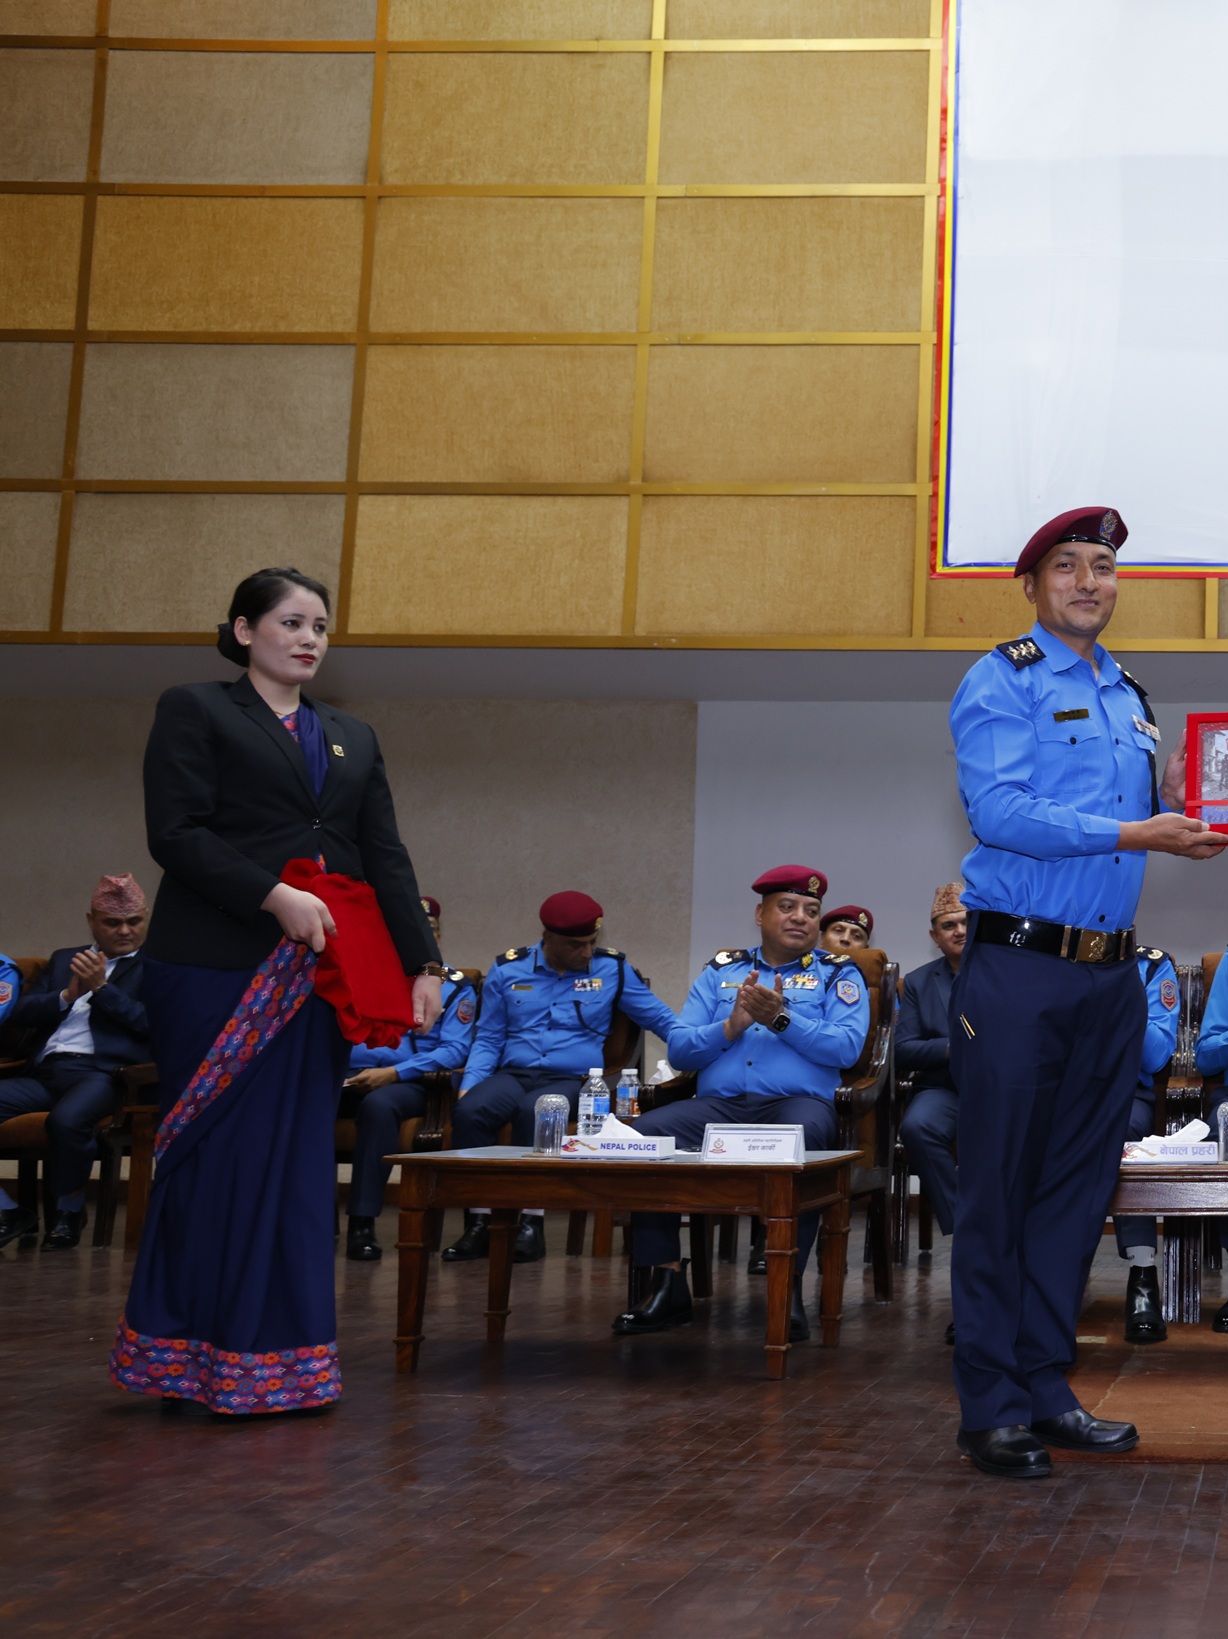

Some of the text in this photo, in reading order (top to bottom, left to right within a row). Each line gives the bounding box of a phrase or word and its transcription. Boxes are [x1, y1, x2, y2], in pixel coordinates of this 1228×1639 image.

[600, 1142, 657, 1151] NEPAL POLICE
[1160, 1144, 1216, 1155] नेपाल प्रहरी
